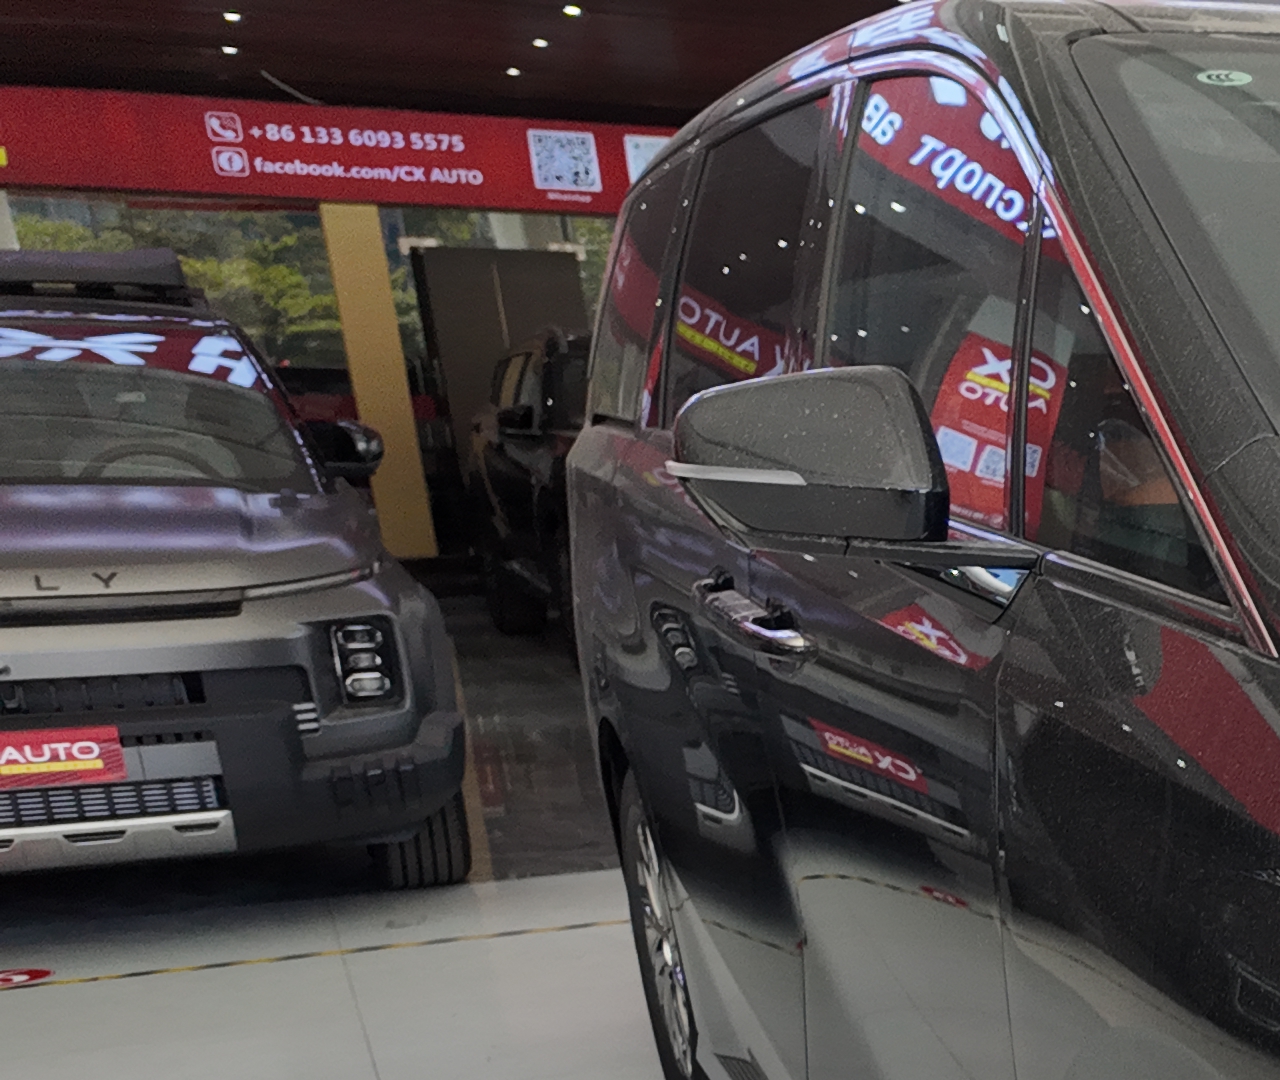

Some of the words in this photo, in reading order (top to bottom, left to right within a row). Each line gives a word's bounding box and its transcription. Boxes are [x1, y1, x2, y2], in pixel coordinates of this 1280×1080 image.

[249, 123, 295, 143] +86
[300, 125, 344, 145] 133
[348, 128, 406, 149] 6093
[410, 132, 466, 153] 5575
[253, 156, 427, 183] facebook.com/CX
[430, 166, 484, 186] AUTO
[0, 741, 101, 765] AUTO
